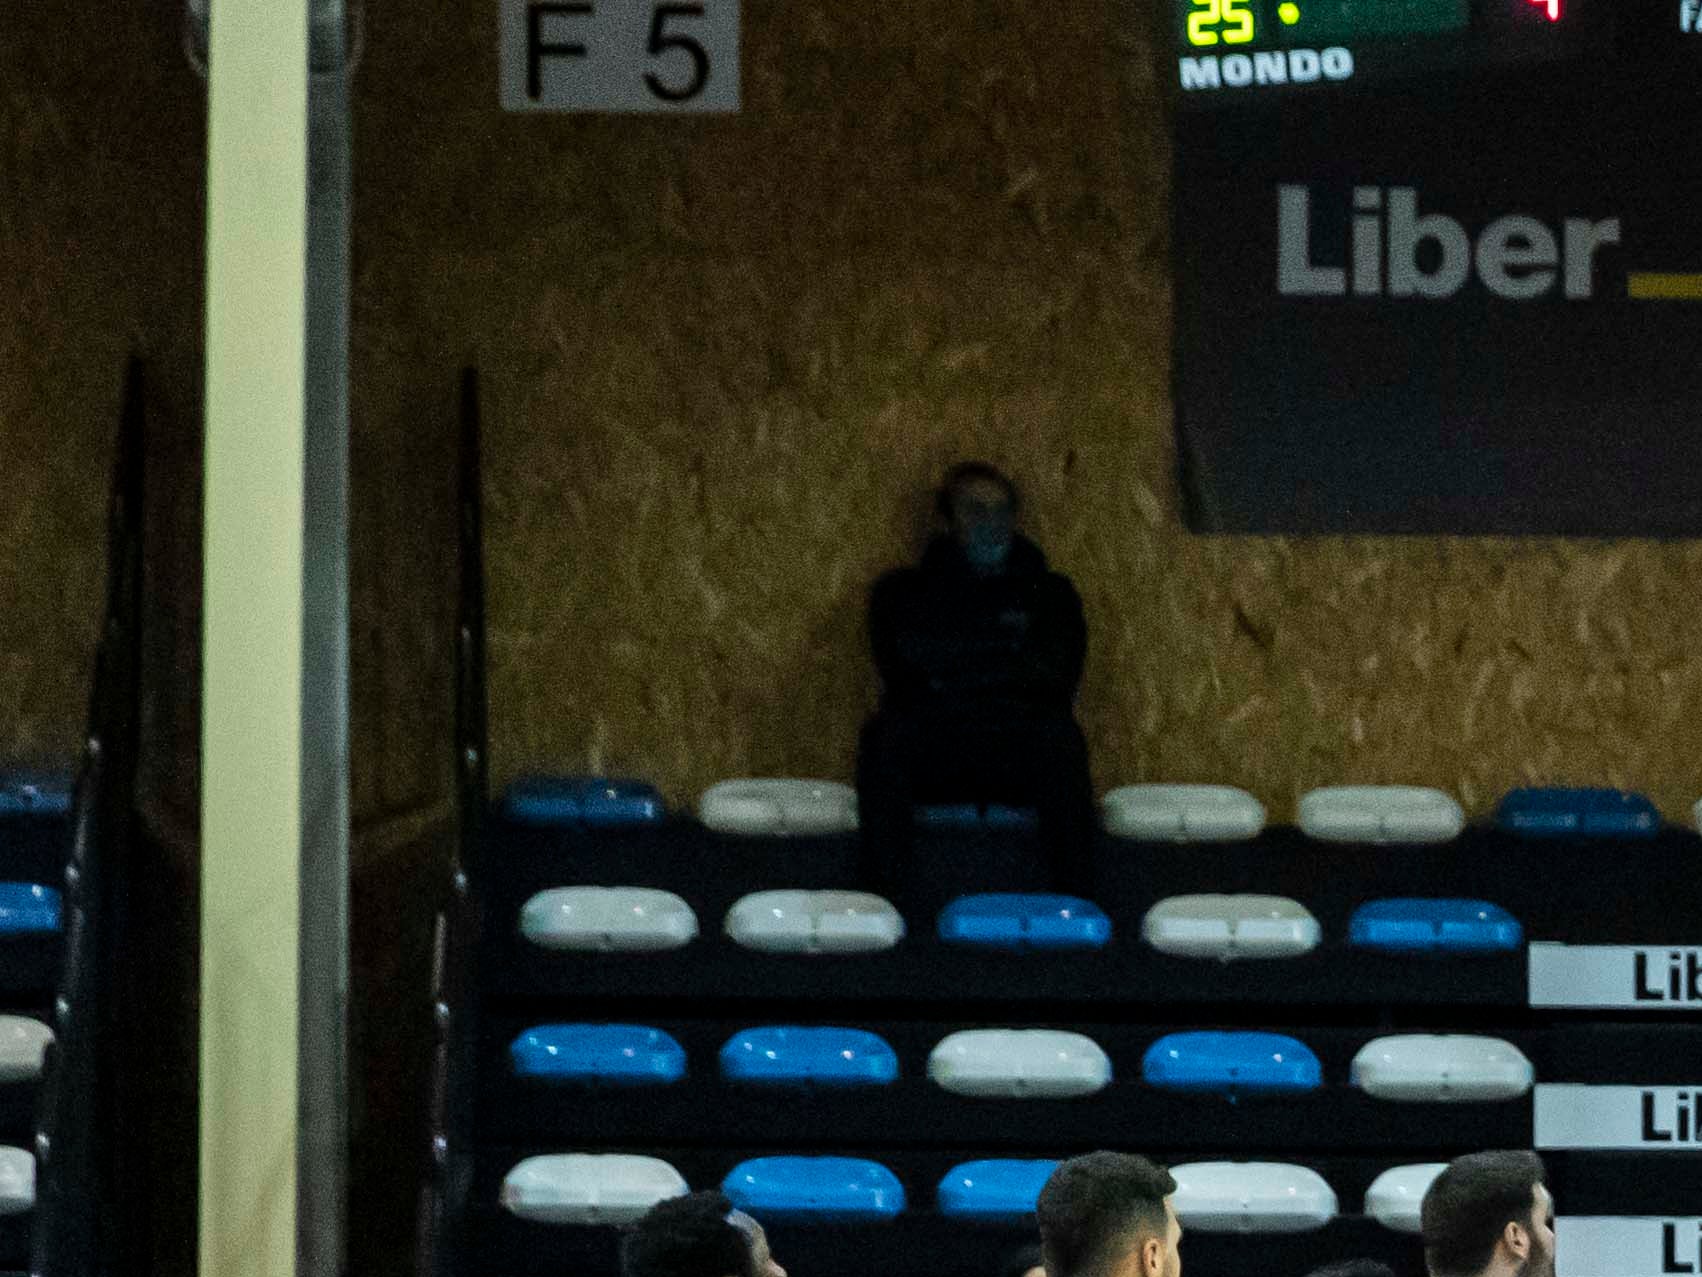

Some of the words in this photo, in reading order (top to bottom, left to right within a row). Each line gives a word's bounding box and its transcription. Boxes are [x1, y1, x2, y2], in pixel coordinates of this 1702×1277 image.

[527, 5, 592, 99] F
[644, 5, 710, 100] 5
[1179, 47, 1354, 91] MONDO
[1277, 185, 1620, 299] Liber
